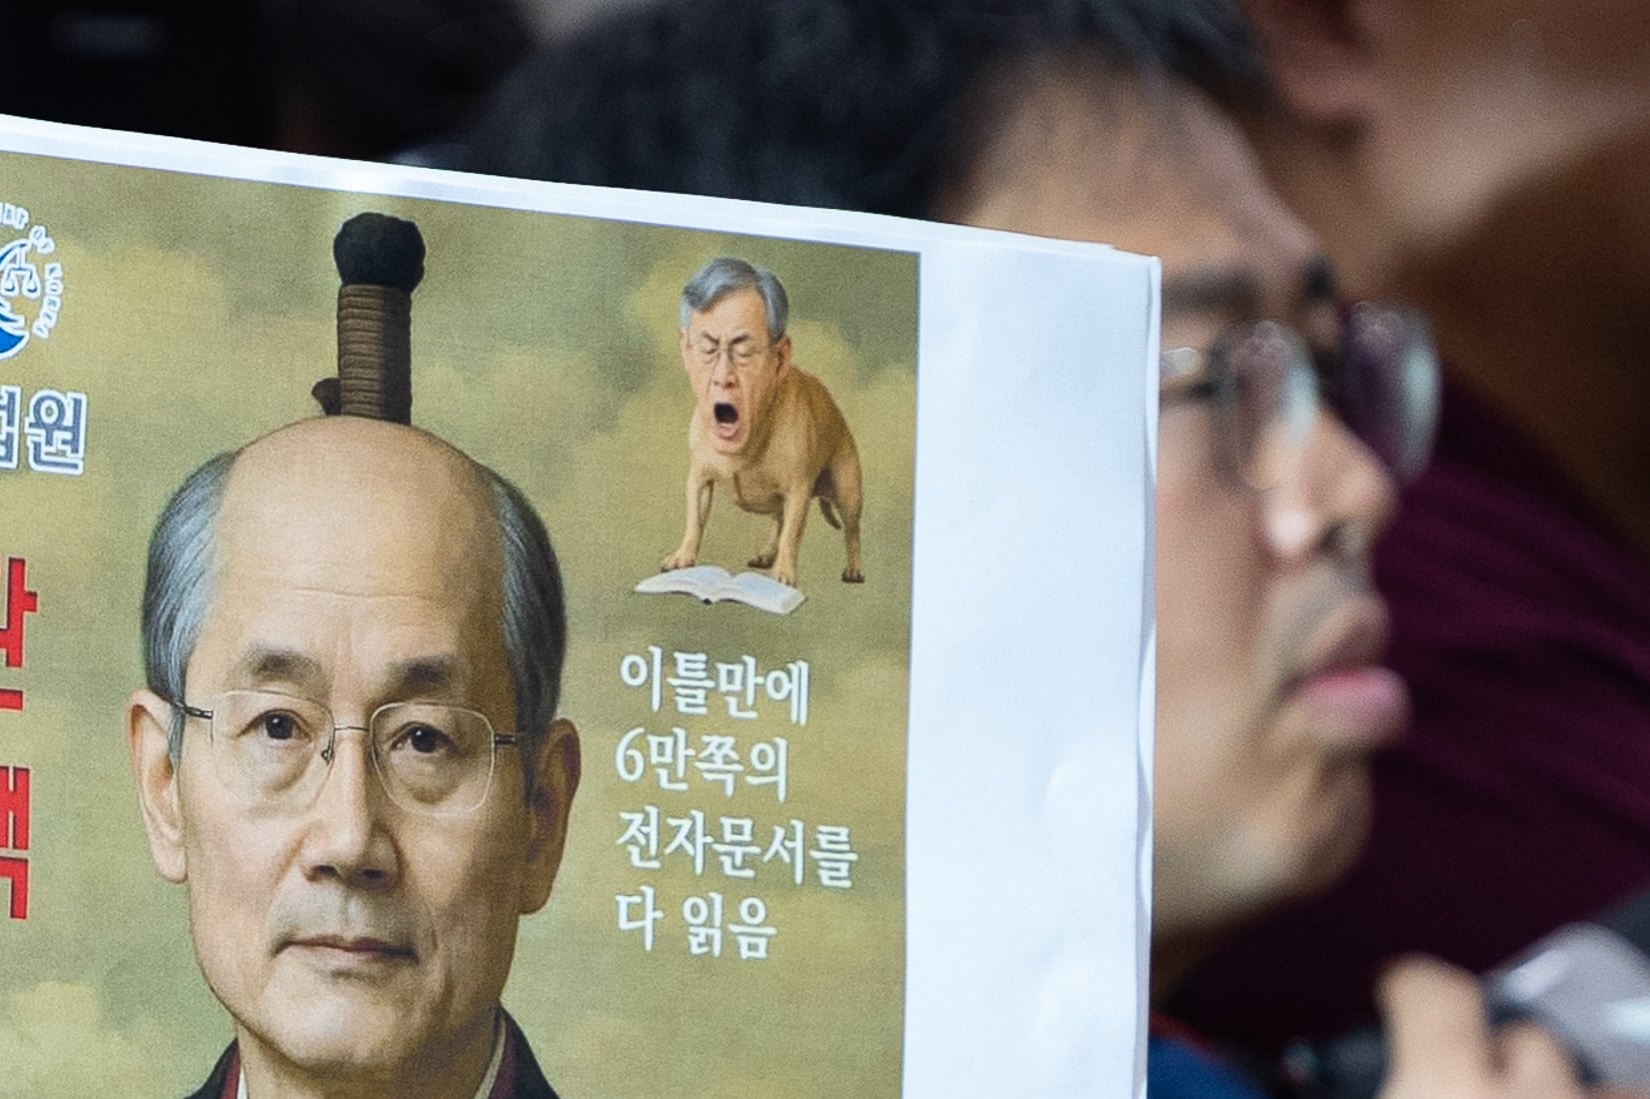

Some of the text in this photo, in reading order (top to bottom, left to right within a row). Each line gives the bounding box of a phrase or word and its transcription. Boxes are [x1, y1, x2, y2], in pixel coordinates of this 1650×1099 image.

[619, 646, 810, 725] 이틀만에
[615, 727, 789, 803] 6만쪽의
[616, 805, 858, 888] 전자문서를
[615, 885, 778, 960] 다 읽음
